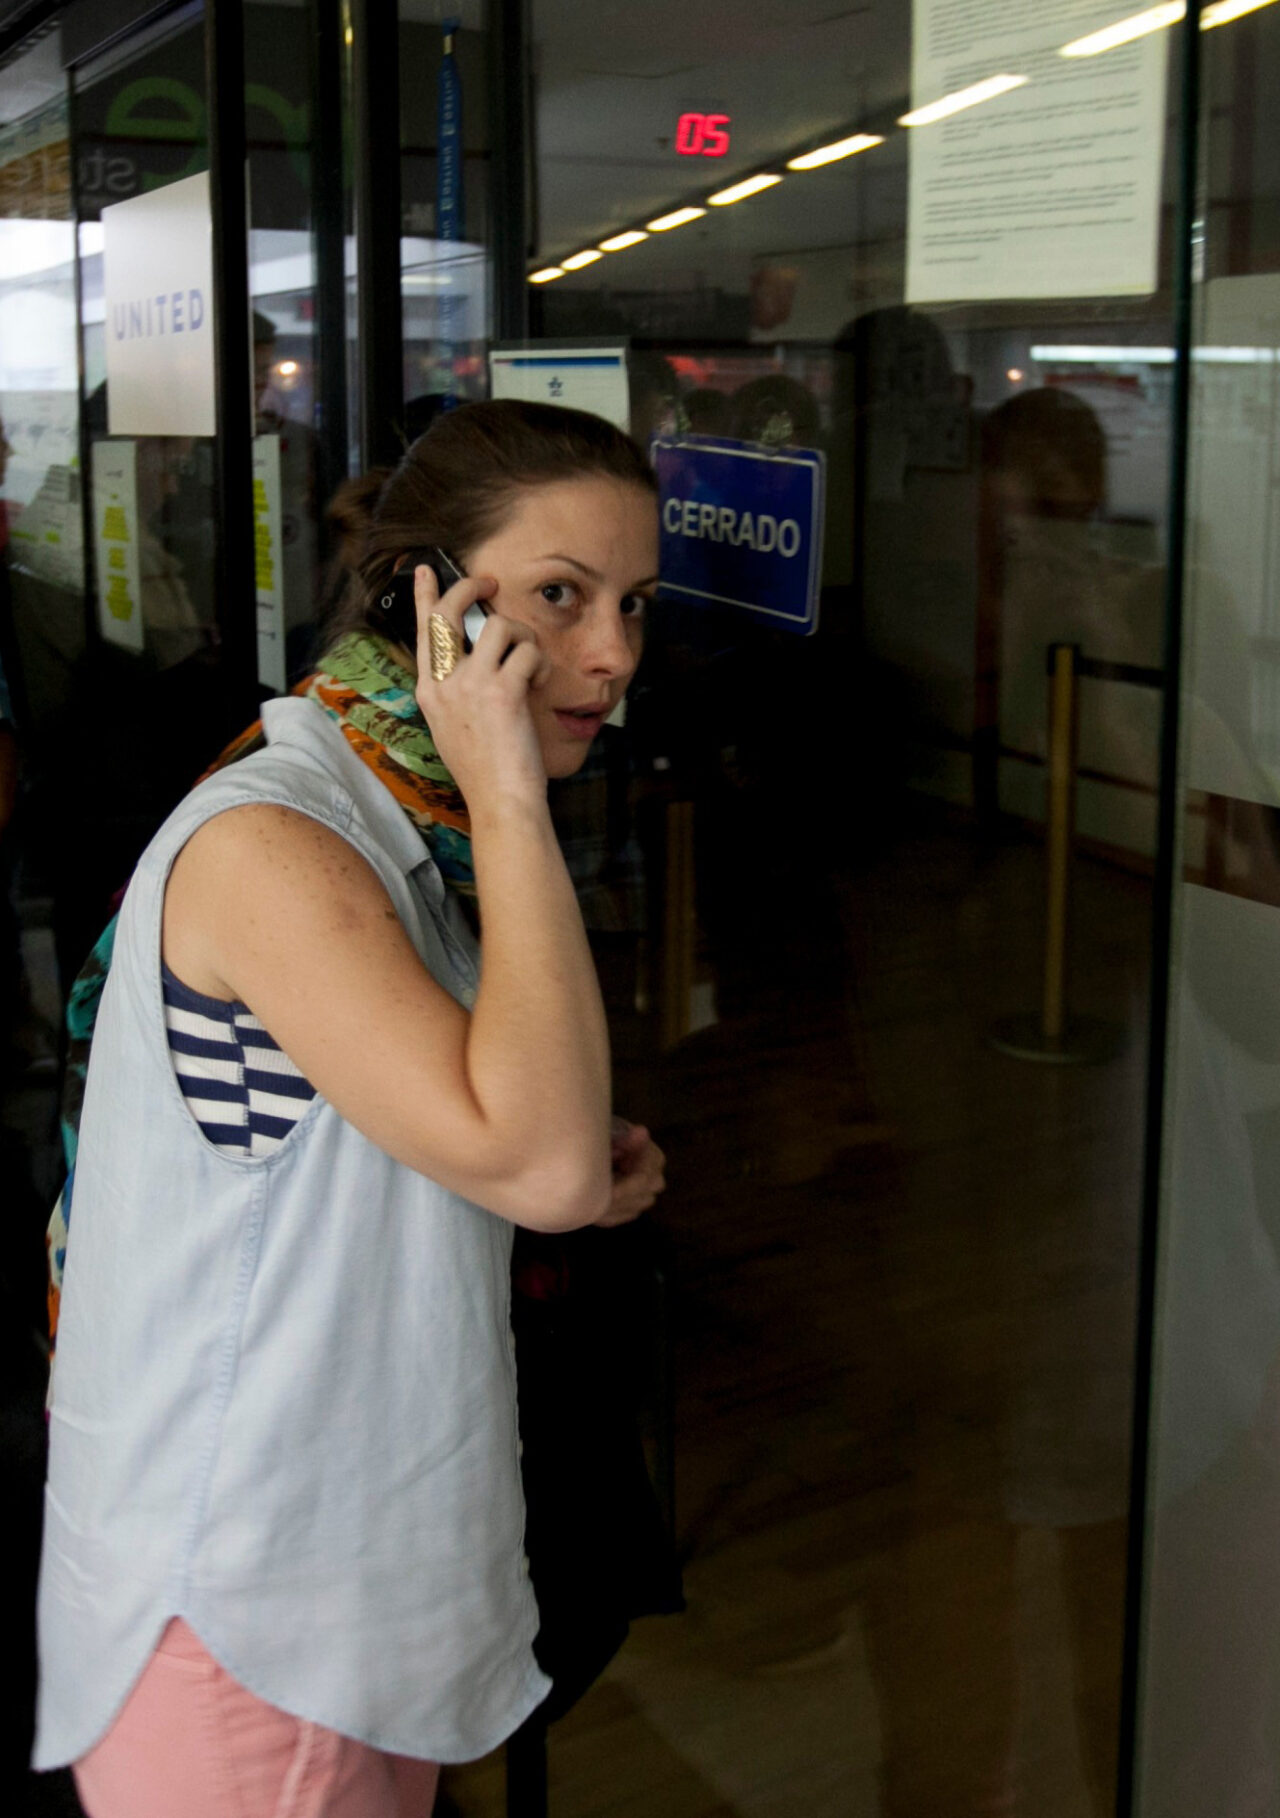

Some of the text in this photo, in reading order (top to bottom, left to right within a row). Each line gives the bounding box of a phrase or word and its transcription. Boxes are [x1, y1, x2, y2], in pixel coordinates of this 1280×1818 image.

[675, 112, 730, 157] 05
[113, 288, 204, 342] UNITED
[663, 497, 801, 559] CERRADO
